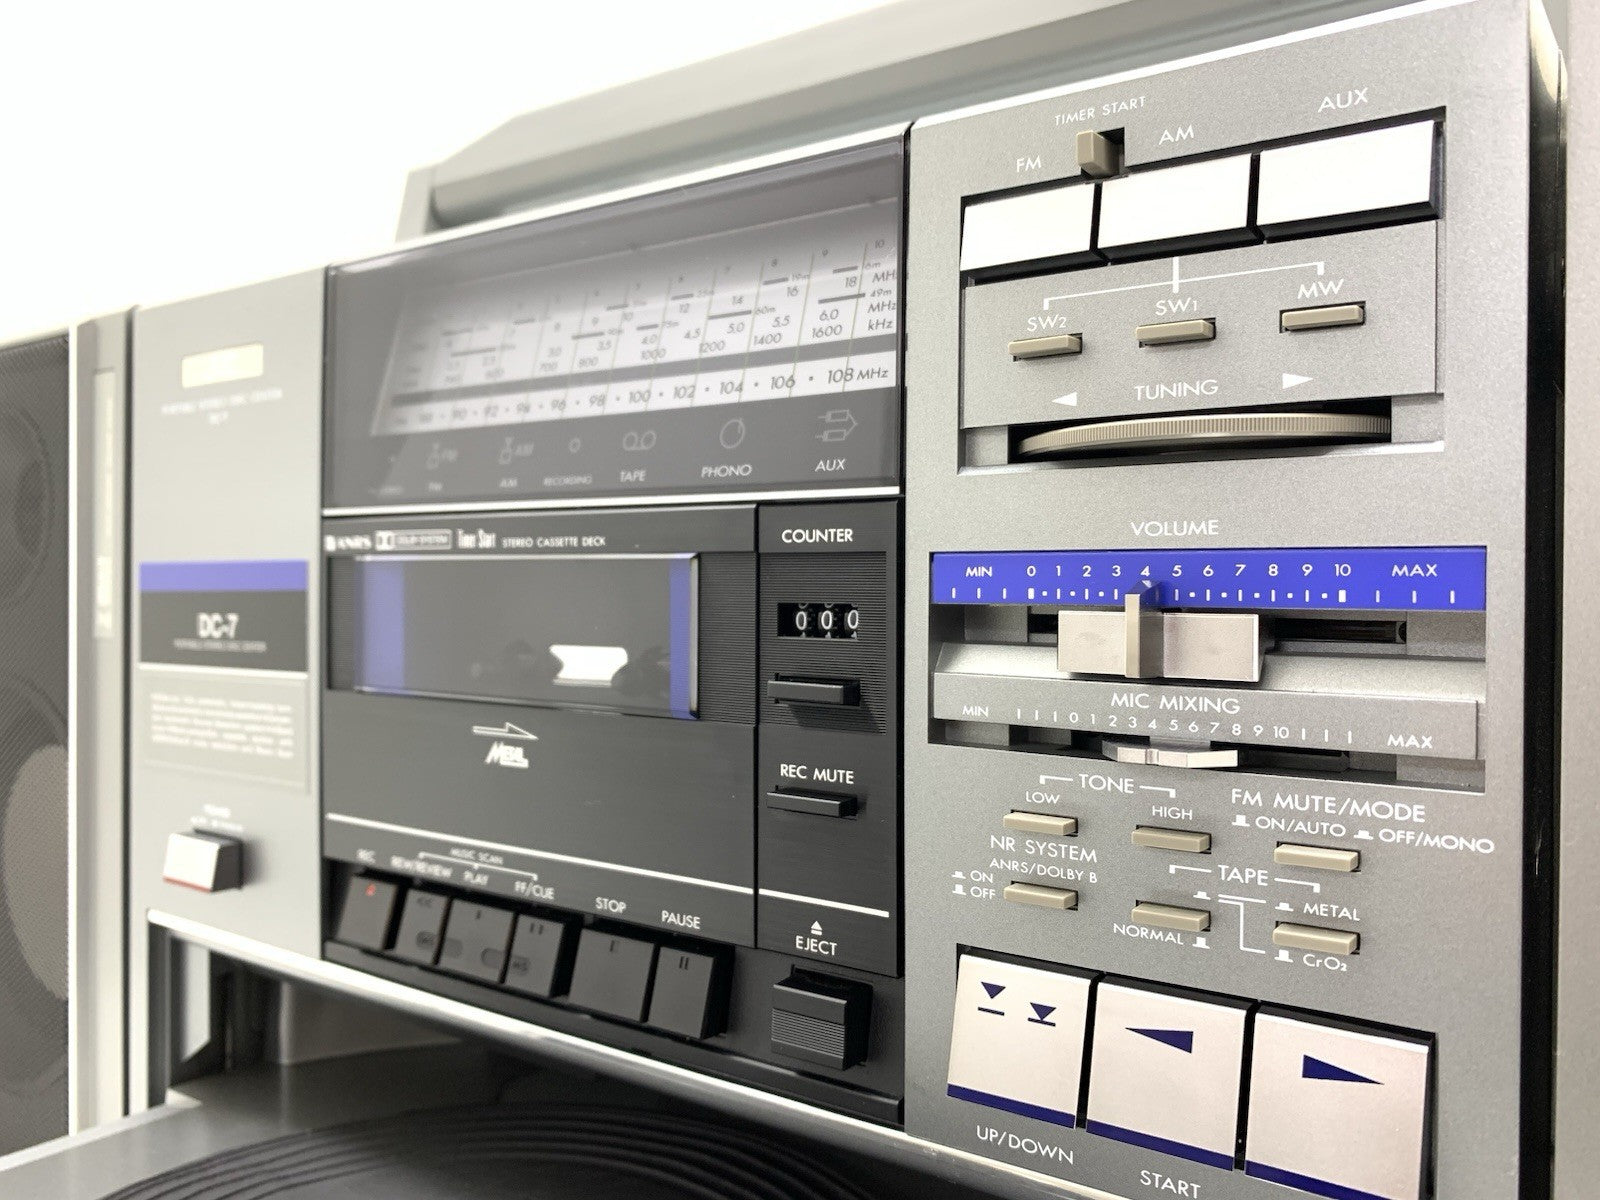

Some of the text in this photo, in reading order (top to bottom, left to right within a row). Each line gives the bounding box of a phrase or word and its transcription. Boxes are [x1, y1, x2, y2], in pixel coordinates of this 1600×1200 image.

[1318, 87, 1368, 112] AUX
[1055, 96, 1145, 125] TIMER START
[1159, 125, 1194, 145] AM
[1017, 155, 1041, 172] FM
[875, 240, 885, 248] 10
[846, 276, 857, 287] 18
[1298, 279, 1344, 299] MW
[727, 322, 744, 334] 5.0
[772, 316, 790, 327] 5.5
[819, 309, 839, 321] 6.0
[868, 300, 896, 313] MHz
[754, 333, 782, 345] 1400
[812, 325, 842, 338] 1600
[868, 319, 892, 330] kHz
[629, 391, 650, 403] 100
[674, 385, 696, 399] 102
[720, 381, 743, 395] 104
[771, 375, 795, 390] 106
[829, 368, 853, 383] 108
[857, 368, 888, 380] MHz
[1134, 379, 1218, 400] TUNING
[620, 459, 846, 482] TAPE PHONO AUX
[782, 529, 852, 543] COUNTER
[1130, 520, 1218, 536] VOLUME
[502, 536, 605, 547] STEREO CASSETTE DECK
[966, 564, 1437, 577] MIN 0 1 2 3 4 5 6 7 8 9 10 MAX
[197, 613, 239, 638] DC-7
[1111, 693, 1240, 714] MIC MIXING
[962, 705, 1432, 748] MIN 0 1 2 3 4 5 6 7 8 9 10 MAX
[781, 764, 853, 784] REC MUTE
[1079, 774, 1133, 793] TONE
[1026, 791, 1060, 803] LOW
[1231, 789, 1426, 823] FM MUTE/MODE
[1152, 806, 1192, 820] HIGH
[1256, 816, 1494, 853] ON/AUTO OFF/MONO
[990, 836, 1098, 863] NR SYSTEM
[970, 870, 993, 883] ON
[989, 859, 1098, 884] ANRS/DOLBY B
[1218, 865, 1268, 886] TAPE
[970, 886, 995, 899] OFF
[595, 897, 626, 913] STOP
[1304, 903, 1360, 921] METAL
[661, 910, 700, 929] PAUSE
[1114, 923, 1183, 945] NORMAL
[796, 936, 837, 955] EJECT
[976, 1125, 1074, 1166] UP/DOWN
[1140, 1170, 1201, 1199] START
